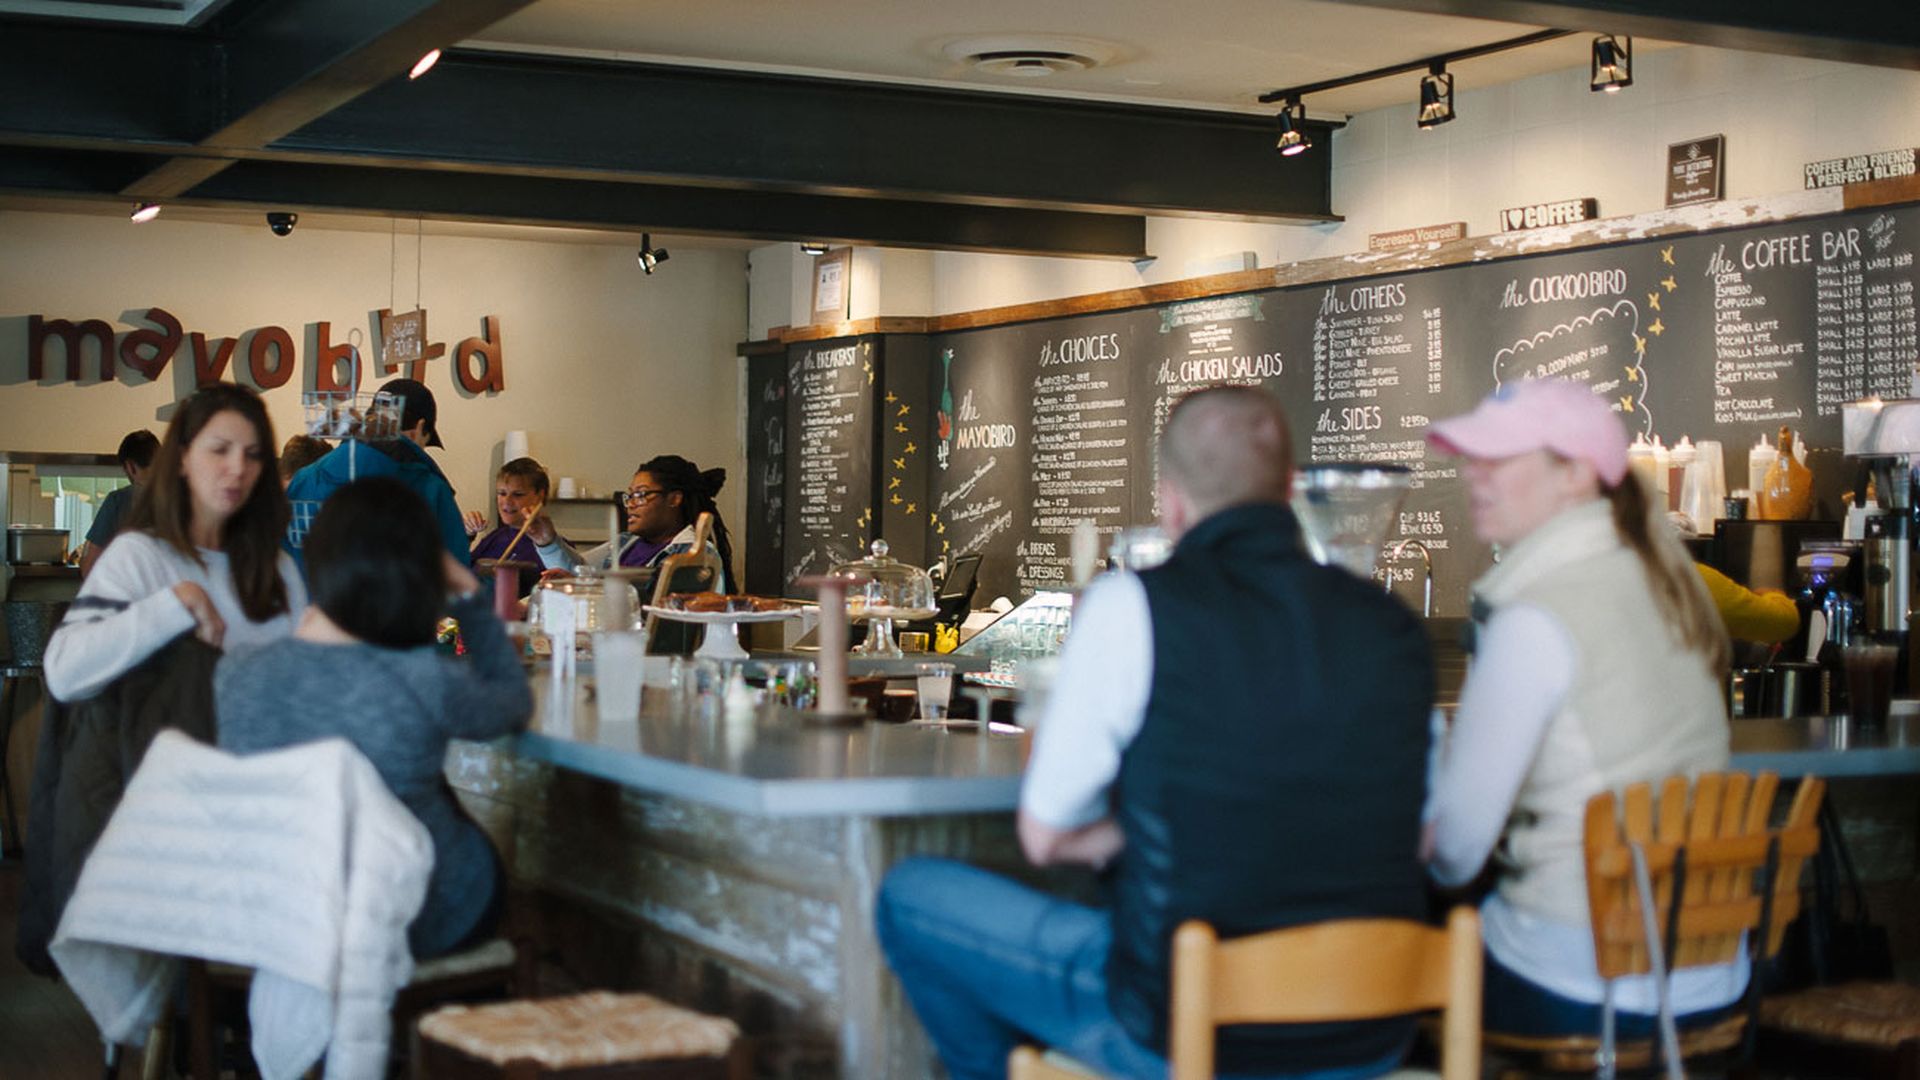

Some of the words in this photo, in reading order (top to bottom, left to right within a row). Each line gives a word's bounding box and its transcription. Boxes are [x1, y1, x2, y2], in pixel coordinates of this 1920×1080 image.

[1805, 159, 1845, 176] COFFEE
[1846, 156, 1868, 171] AND
[1870, 149, 1915, 168] FRIENDS
[1806, 175, 1817, 189] A
[1818, 168, 1871, 188] PERFECT
[1873, 161, 1916, 180] BLEND
[1503, 210, 1509, 231] I
[1525, 200, 1584, 227] COFFEE
[1370, 233, 1415, 250] Espresso
[1417, 224, 1461, 243] Yourself
[1705, 244, 1735, 277] the
[1742, 234, 1812, 270] COFFEE
[1822, 229, 1862, 260] BAR
[1715, 272, 1742, 285] COFFEE
[1817, 265, 1841, 275] SMALL
[1866, 258, 1892, 270] LARGE
[1500, 279, 1528, 309] the
[1817, 278, 1842, 288] SMALL
[1319, 285, 1349, 315] the
[1351, 283, 1406, 312] OTHERS
[1715, 310, 1742, 322] LATTE
[1754, 320, 1779, 331] LATTE
[1040, 340, 1060, 367] the
[1060, 333, 1120, 364] CHOICES
[1747, 333, 1771, 343] LATTE
[1781, 342, 1805, 354] LATTE
[1155, 358, 1179, 385] the
[1180, 358, 1228, 383] CHICKEN
[1231, 352, 1283, 378] SALADS
[1715, 384, 1731, 396] TEA
[958, 389, 980, 422] the
[1316, 408, 1341, 432] the
[1341, 406, 1382, 431] SIDES
[957, 424, 1016, 450] MAYOBIRD
[1030, 542, 1056, 556] BREADS
[1029, 565, 1065, 579] DRESSINGS
